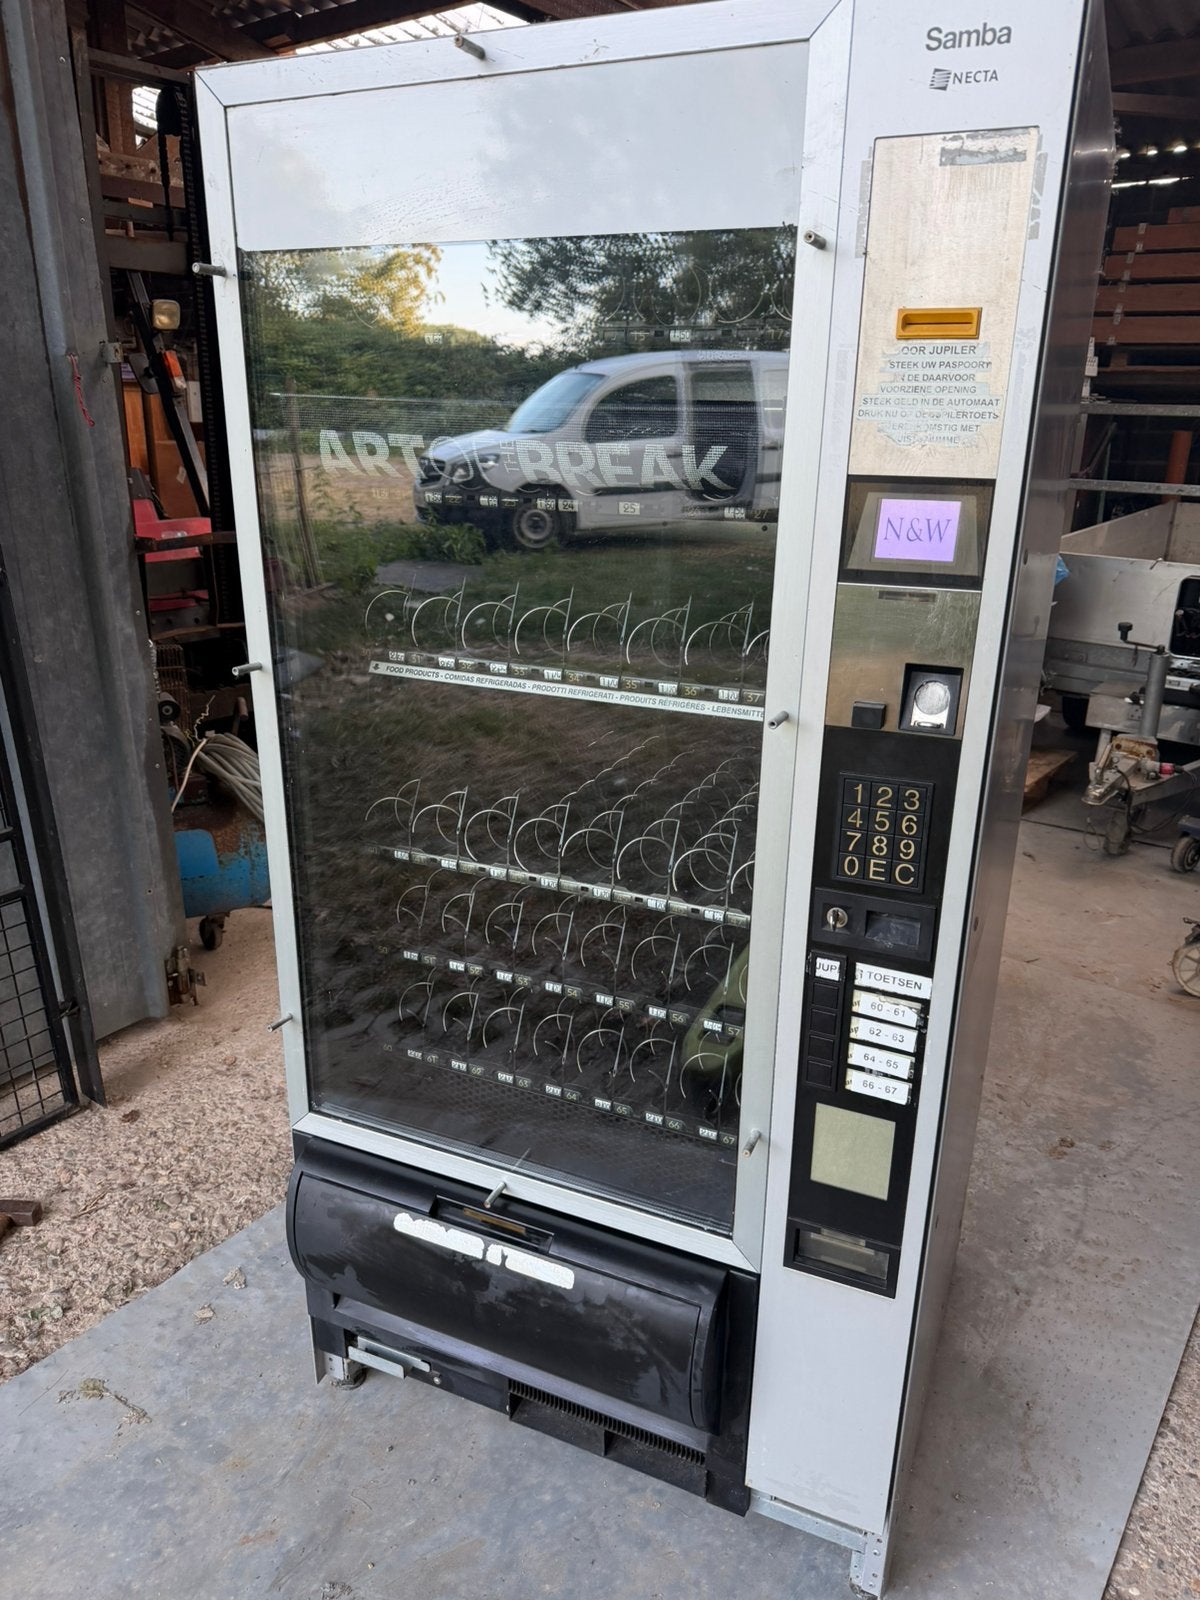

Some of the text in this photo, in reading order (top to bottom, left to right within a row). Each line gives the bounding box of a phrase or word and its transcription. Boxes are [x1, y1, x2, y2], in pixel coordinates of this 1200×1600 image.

[925, 22, 1012, 51] Samba
[952, 69, 999, 85] NECTA
[901, 345, 976, 355] OOR JUPILER
[889, 360, 992, 369] STEEK UW PASPOORT
[922, 373, 976, 382] DAARVOOR
[880, 385, 977, 394] VOORZIENE OPENING
[947, 398, 1001, 407] AUTOMAAT
[320, 430, 428, 480] ART
[516, 440, 738, 490] BREAK
[562, 501, 574, 510] 24
[623, 503, 636, 513] 25
[884, 517, 952, 543] N&W
[386, 665, 404, 673] FOOD
[405, 668, 440, 678] PRODUCTS
[444, 673, 474, 683] COMIDAS
[476, 677, 526, 689] REFRIGERADAS
[531, 684, 567, 694] PRODOTTI
[568, 688, 614, 700] REFRIGERATI
[620, 694, 657, 705] PRODUITS
[625, 680, 638, 689] 35
[684, 686, 697, 696] 36
[854, 784, 919, 810] 1 2 3
[847, 808, 917, 835] 4 5 6
[847, 832, 915, 860] 7 8 9
[869, 859, 886, 880] E
[895, 864, 915, 885] C
[867, 971, 922, 990] TOETSEN
[567, 988, 578, 997] 54
[618, 1001, 630, 1010] 55
[672, 1014, 684, 1022] 56
[727, 1027, 740, 1035] 57
[871, 1002, 883, 1012] 60
[894, 1008, 906, 1017] 61
[869, 1027, 882, 1037] 62
[892, 1033, 905, 1043] 63
[864, 1053, 875, 1062] 64
[886, 1059, 899, 1070] 65
[862, 1080, 874, 1089] 66
[885, 1085, 897, 1095] 67
[518, 1078, 528, 1088] 63
[566, 1092, 577, 1101] 64
[616, 1106, 627, 1115] 65
[668, 1121, 680, 1130] 66
[723, 1136, 735, 1145] 67
